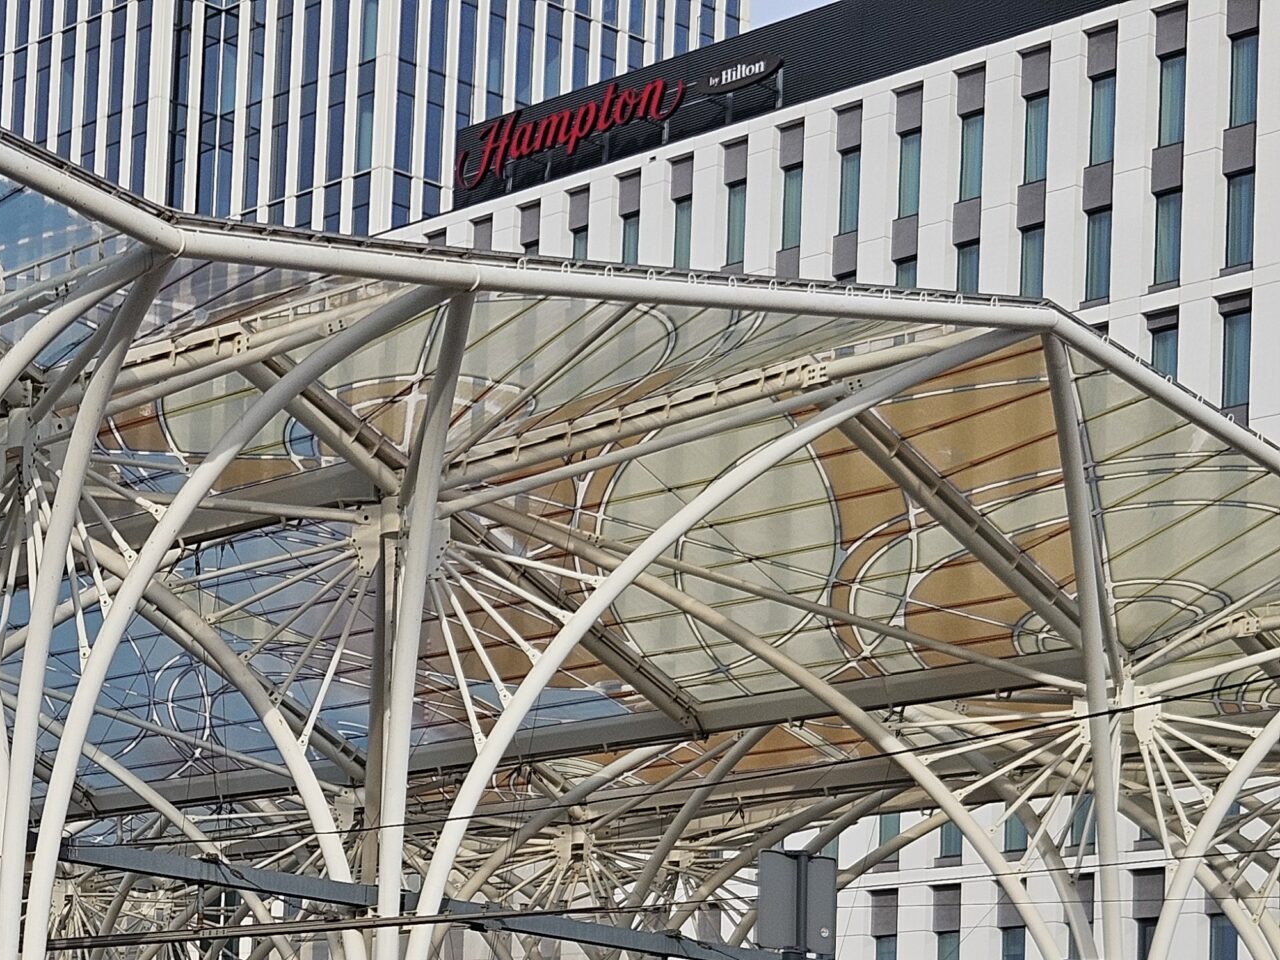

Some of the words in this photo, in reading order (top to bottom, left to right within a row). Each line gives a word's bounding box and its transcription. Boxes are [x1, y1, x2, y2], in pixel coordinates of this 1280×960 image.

[708, 74, 720, 87] by
[721, 57, 766, 85] Hilton
[456, 77, 686, 190] Hampton
